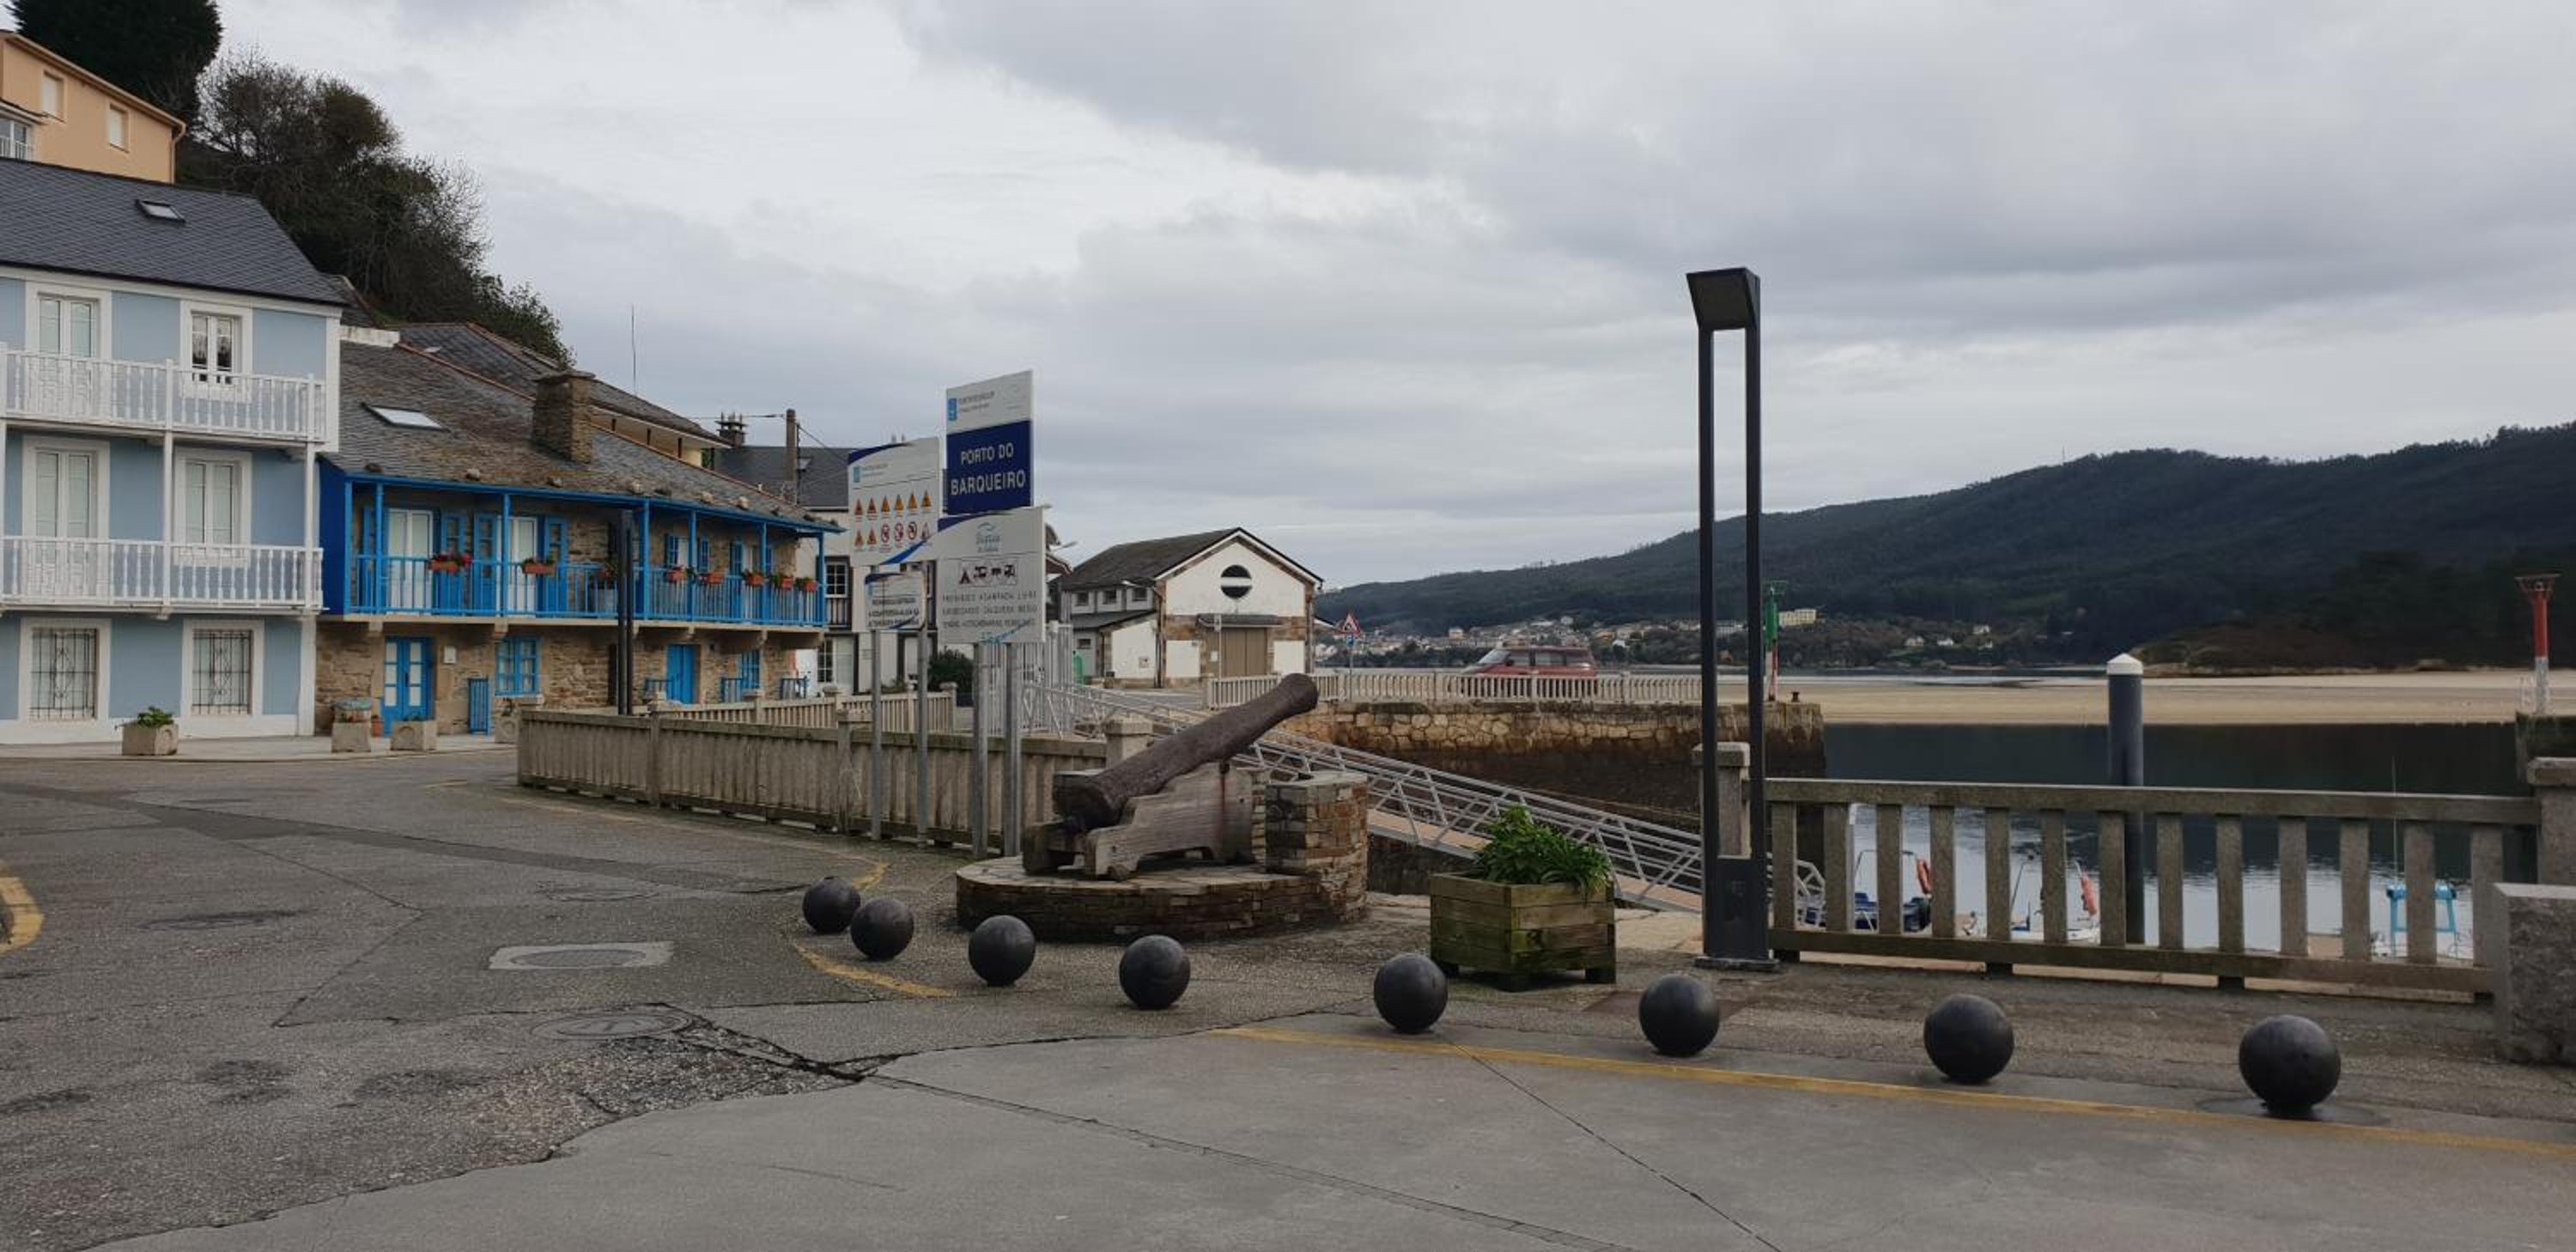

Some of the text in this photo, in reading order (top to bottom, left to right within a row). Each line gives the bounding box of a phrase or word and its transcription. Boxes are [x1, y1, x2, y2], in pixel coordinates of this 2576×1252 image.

[961, 442, 1014, 465] PORTO DO
[951, 469, 1026, 495] BARQUEIRO
